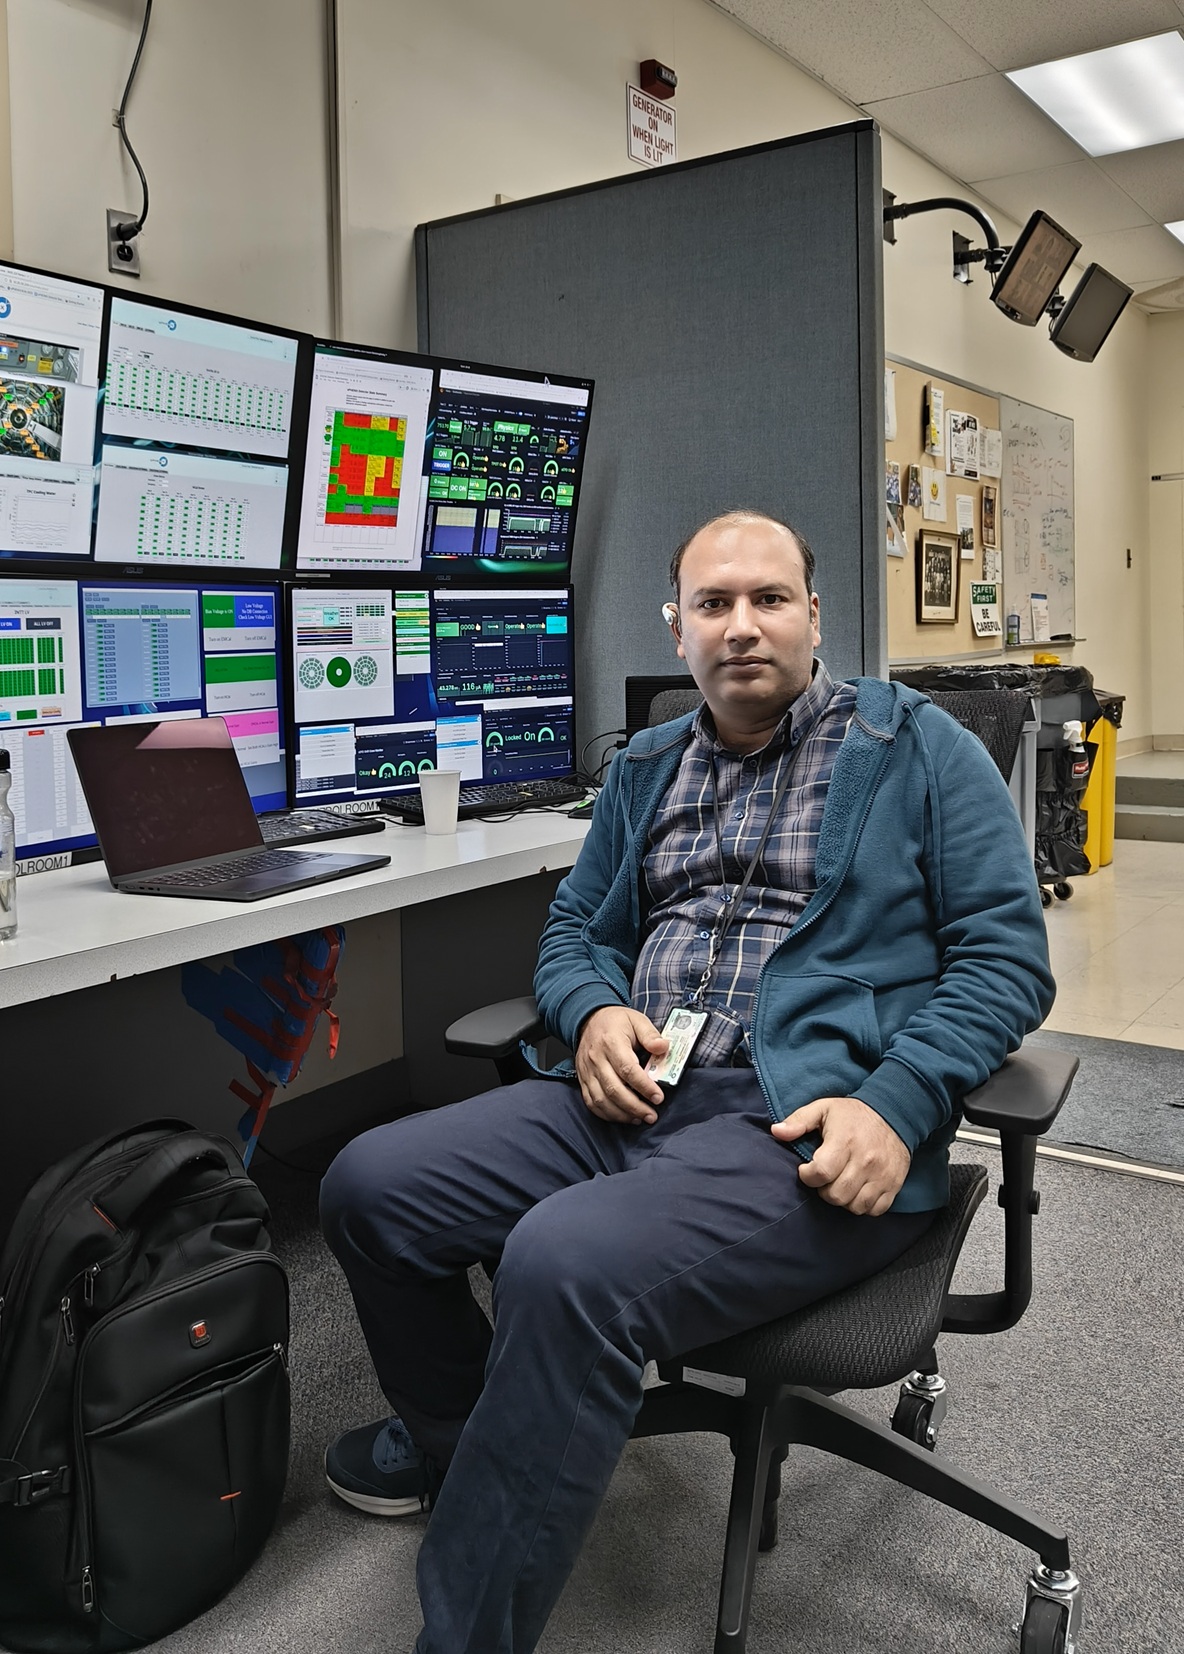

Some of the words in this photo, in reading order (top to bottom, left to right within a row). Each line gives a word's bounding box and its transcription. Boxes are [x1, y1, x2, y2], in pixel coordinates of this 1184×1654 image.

[632, 94, 672, 126] GENERATOR
[648, 117, 658, 132] ON
[632, 124, 653, 146] WHEN
[654, 136, 673, 155] LIGHT
[644, 144, 652, 158] IS
[653, 148, 663, 164] LIT
[973, 586, 996, 597] SAFETY
[982, 609, 990, 618] BE
[976, 621, 1001, 632] CAREFUL
[524, 731, 536, 741] On
